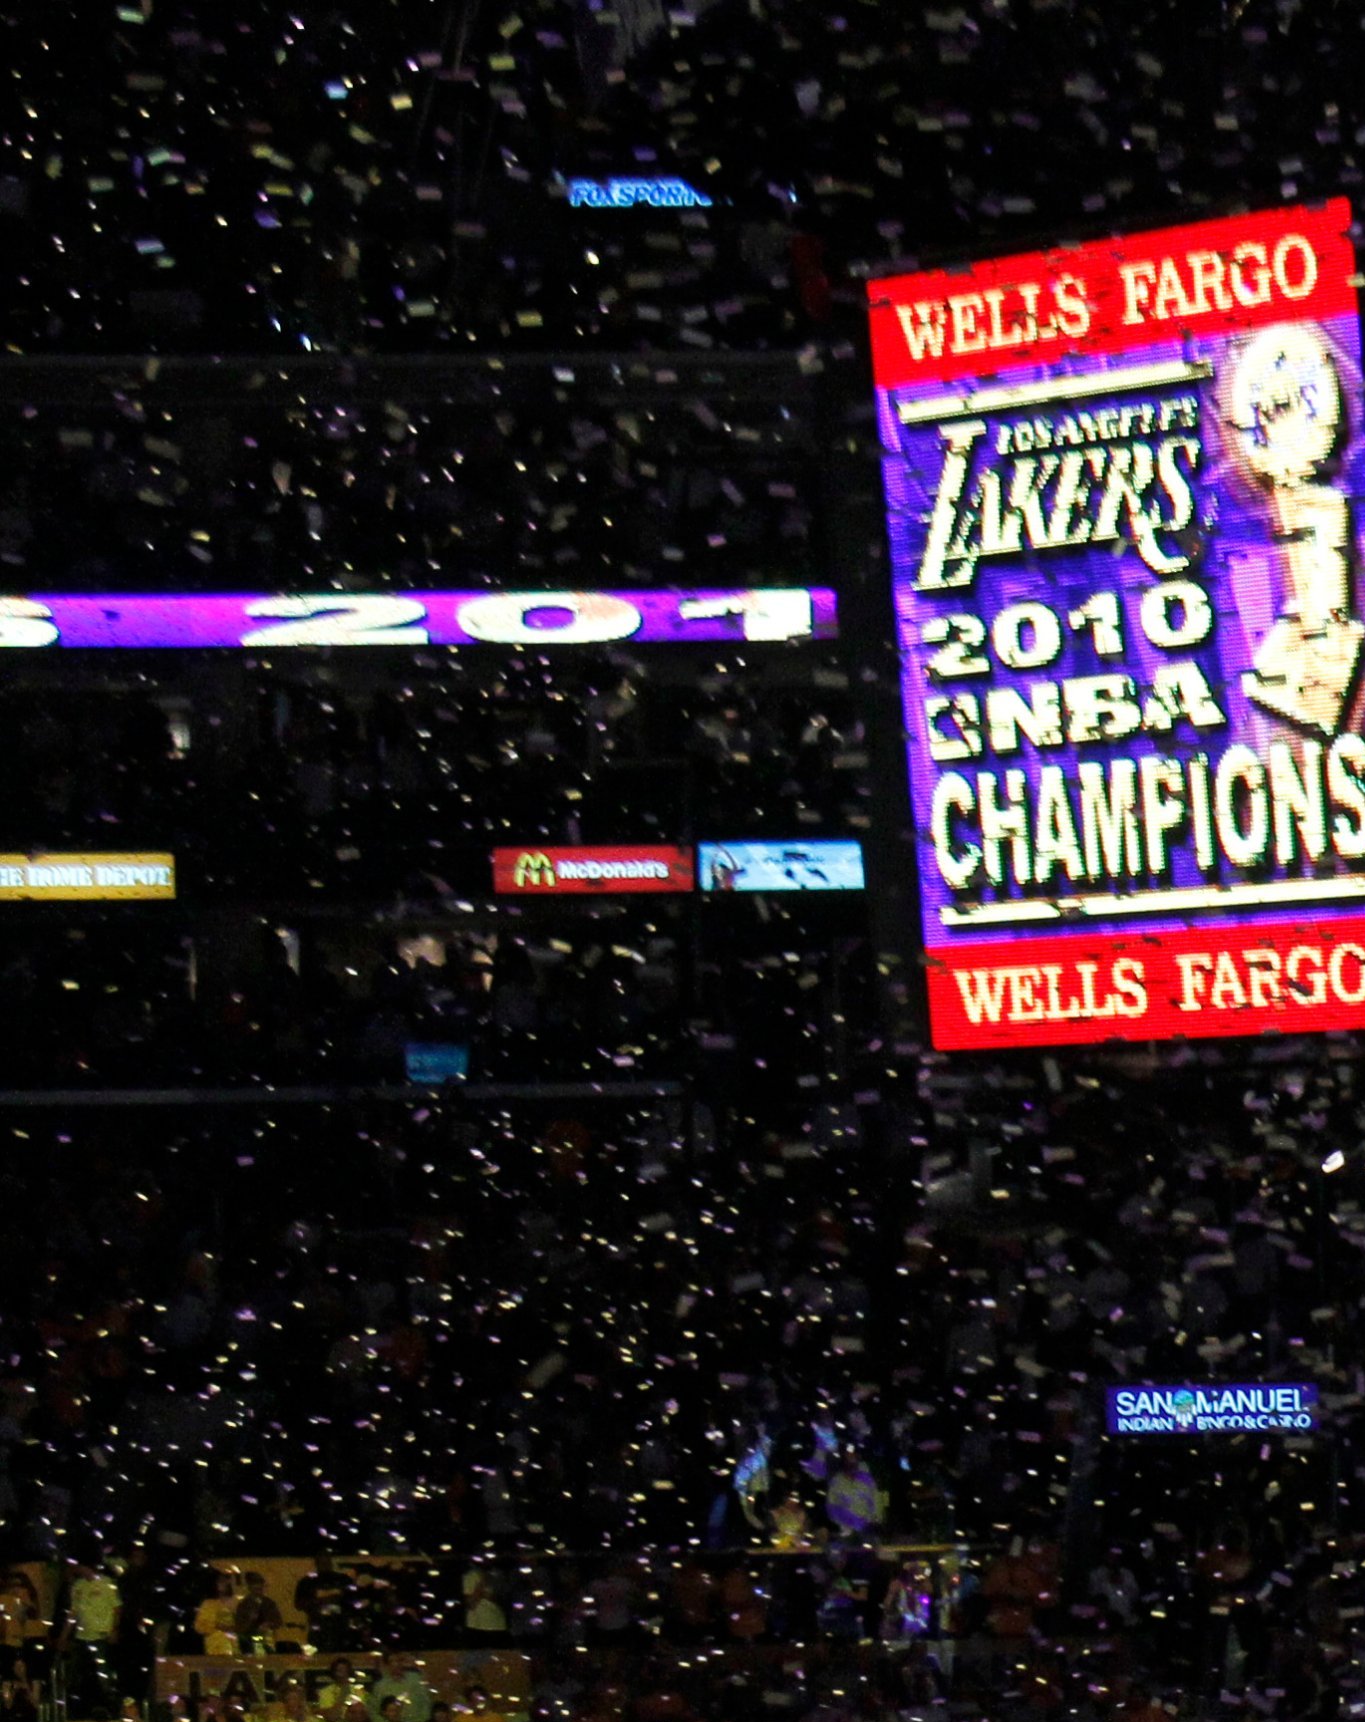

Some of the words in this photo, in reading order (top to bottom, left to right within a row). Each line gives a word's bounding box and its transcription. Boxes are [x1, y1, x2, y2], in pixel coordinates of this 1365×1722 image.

[896, 270, 1090, 362] WELLS
[1120, 234, 1317, 325] FARGO
[911, 418, 1199, 592] LAKERS
[241, 589, 812, 648] 201
[920, 580, 1212, 678] 2010
[985, 661, 1226, 751] NBA
[556, 859, 669, 880] McDonald's
[954, 957, 1148, 1026] WELLS
[1116, 1391, 1176, 1416] SAN
